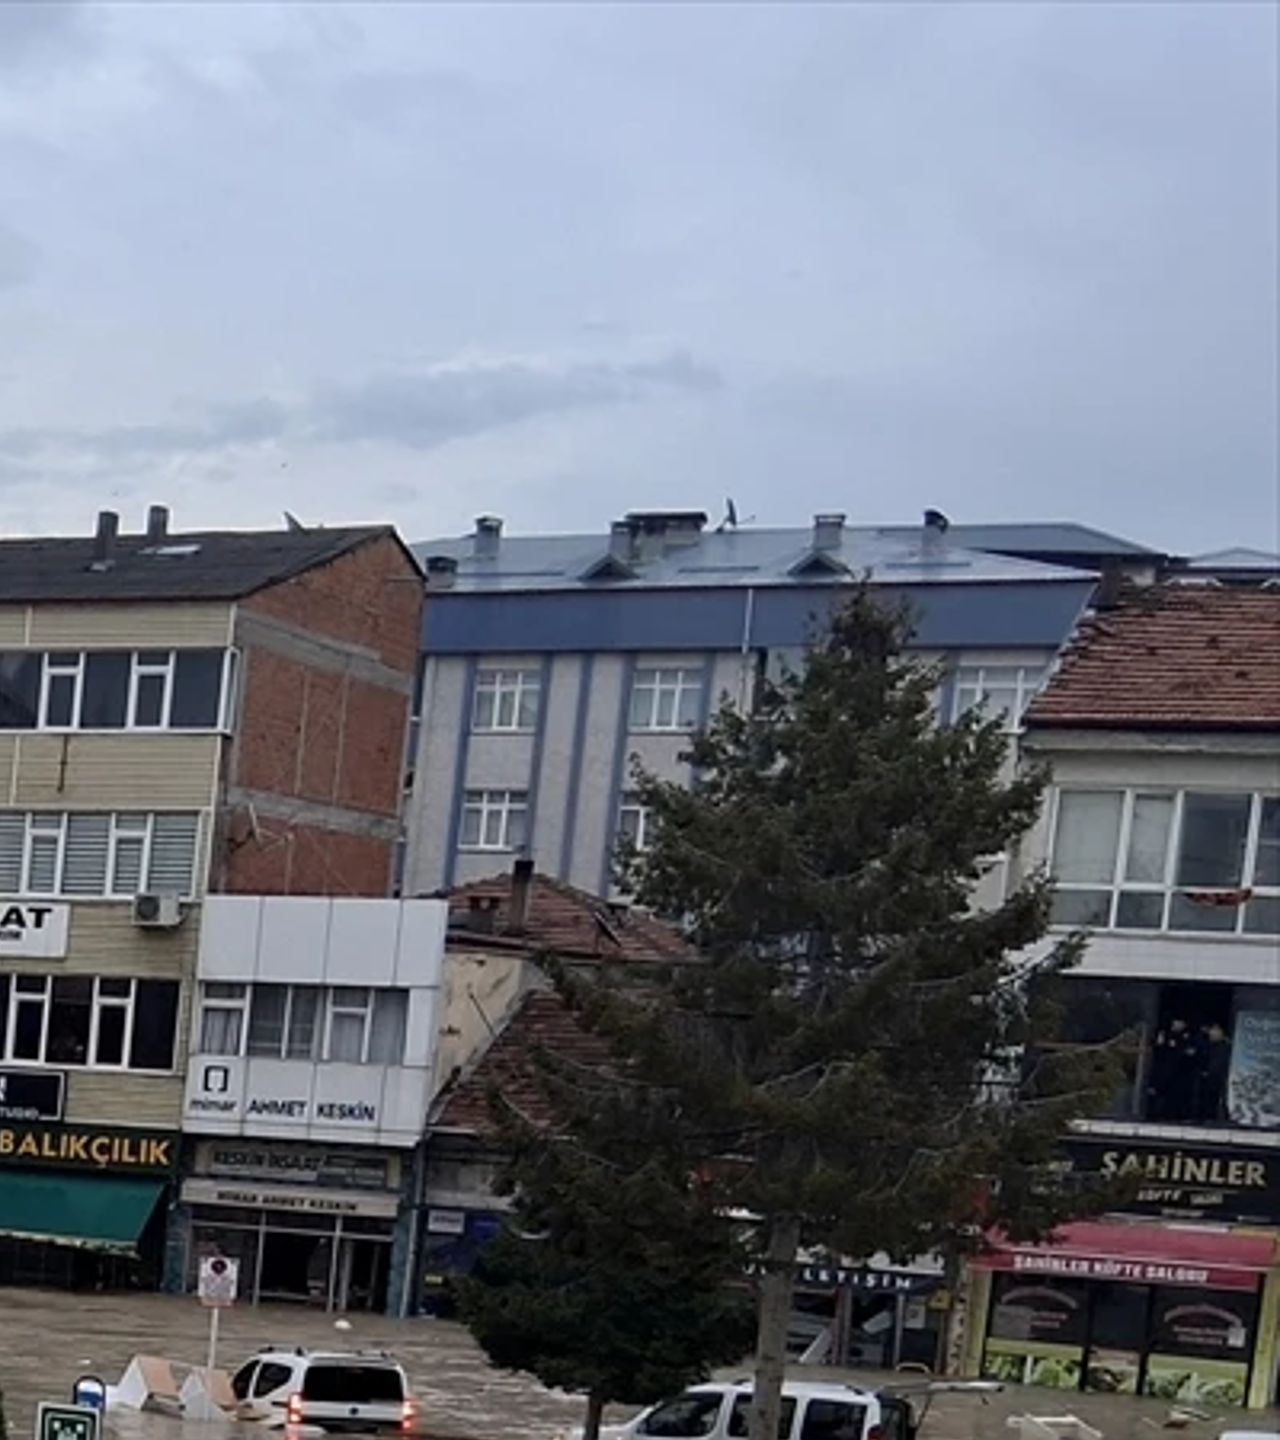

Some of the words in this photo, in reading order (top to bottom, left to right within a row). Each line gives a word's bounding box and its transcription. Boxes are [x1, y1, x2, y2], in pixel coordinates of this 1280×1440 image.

[191, 1098, 237, 1111] mimar
[248, 1100, 307, 1117] AHMET
[316, 1101, 375, 1121] KESKİN
[1100, 1151, 1267, 1187] ŞAHİNLER
[1093, 1261, 1142, 1277] KÖFTE
